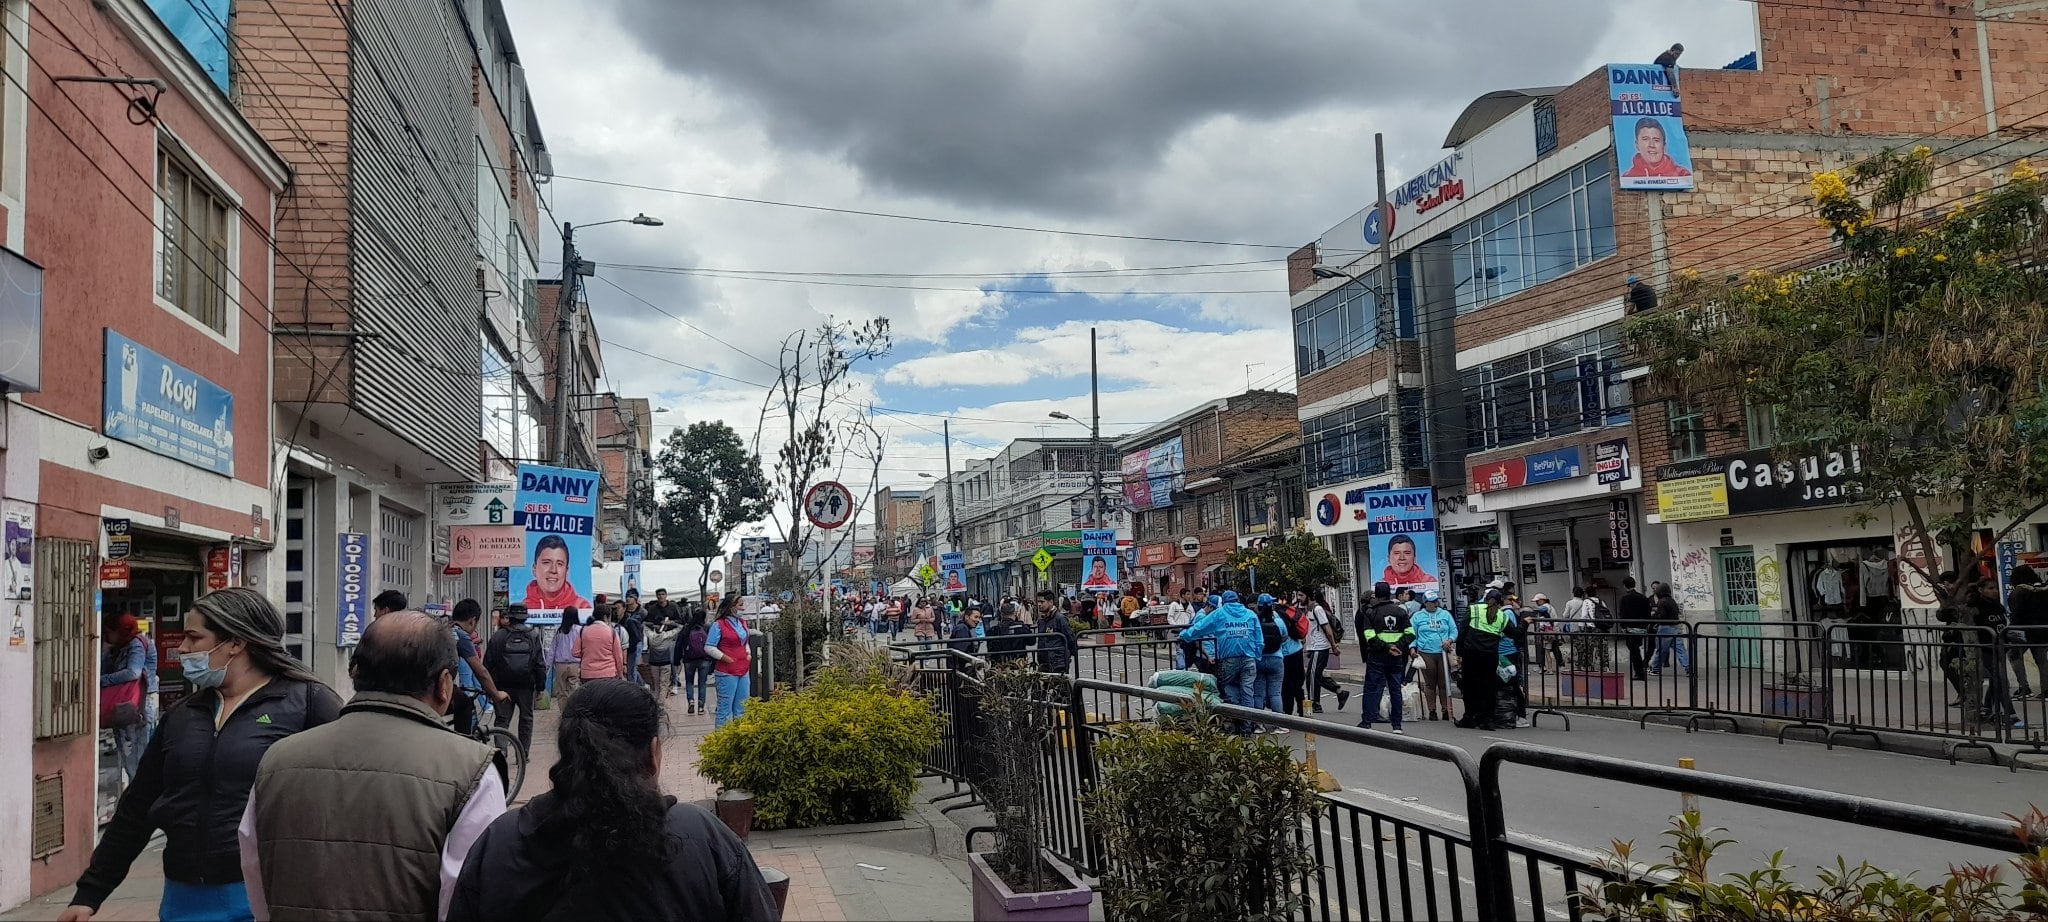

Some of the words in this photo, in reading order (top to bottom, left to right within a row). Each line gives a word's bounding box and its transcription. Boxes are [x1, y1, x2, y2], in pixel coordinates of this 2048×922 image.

[1622, 102, 1673, 115] ALCALDE
[1395, 155, 1457, 210] AMERICAN
[1534, 459, 1555, 471] BetPlay
[1729, 443, 1862, 490] Casual
[522, 472, 594, 496] DANNY
[1489, 475, 1507, 485] TODO
[1605, 472, 1620, 481] PISO
[1370, 493, 1428, 510] DANNY
[492, 511, 501, 522] 3
[525, 514, 584, 533] ALCALDE
[1378, 520, 1426, 533] ALCALDE
[1617, 501, 1631, 559] INGLES
[2003, 543, 2013, 577] FAJAS
[344, 535, 362, 632] FOTOCOPIAS
